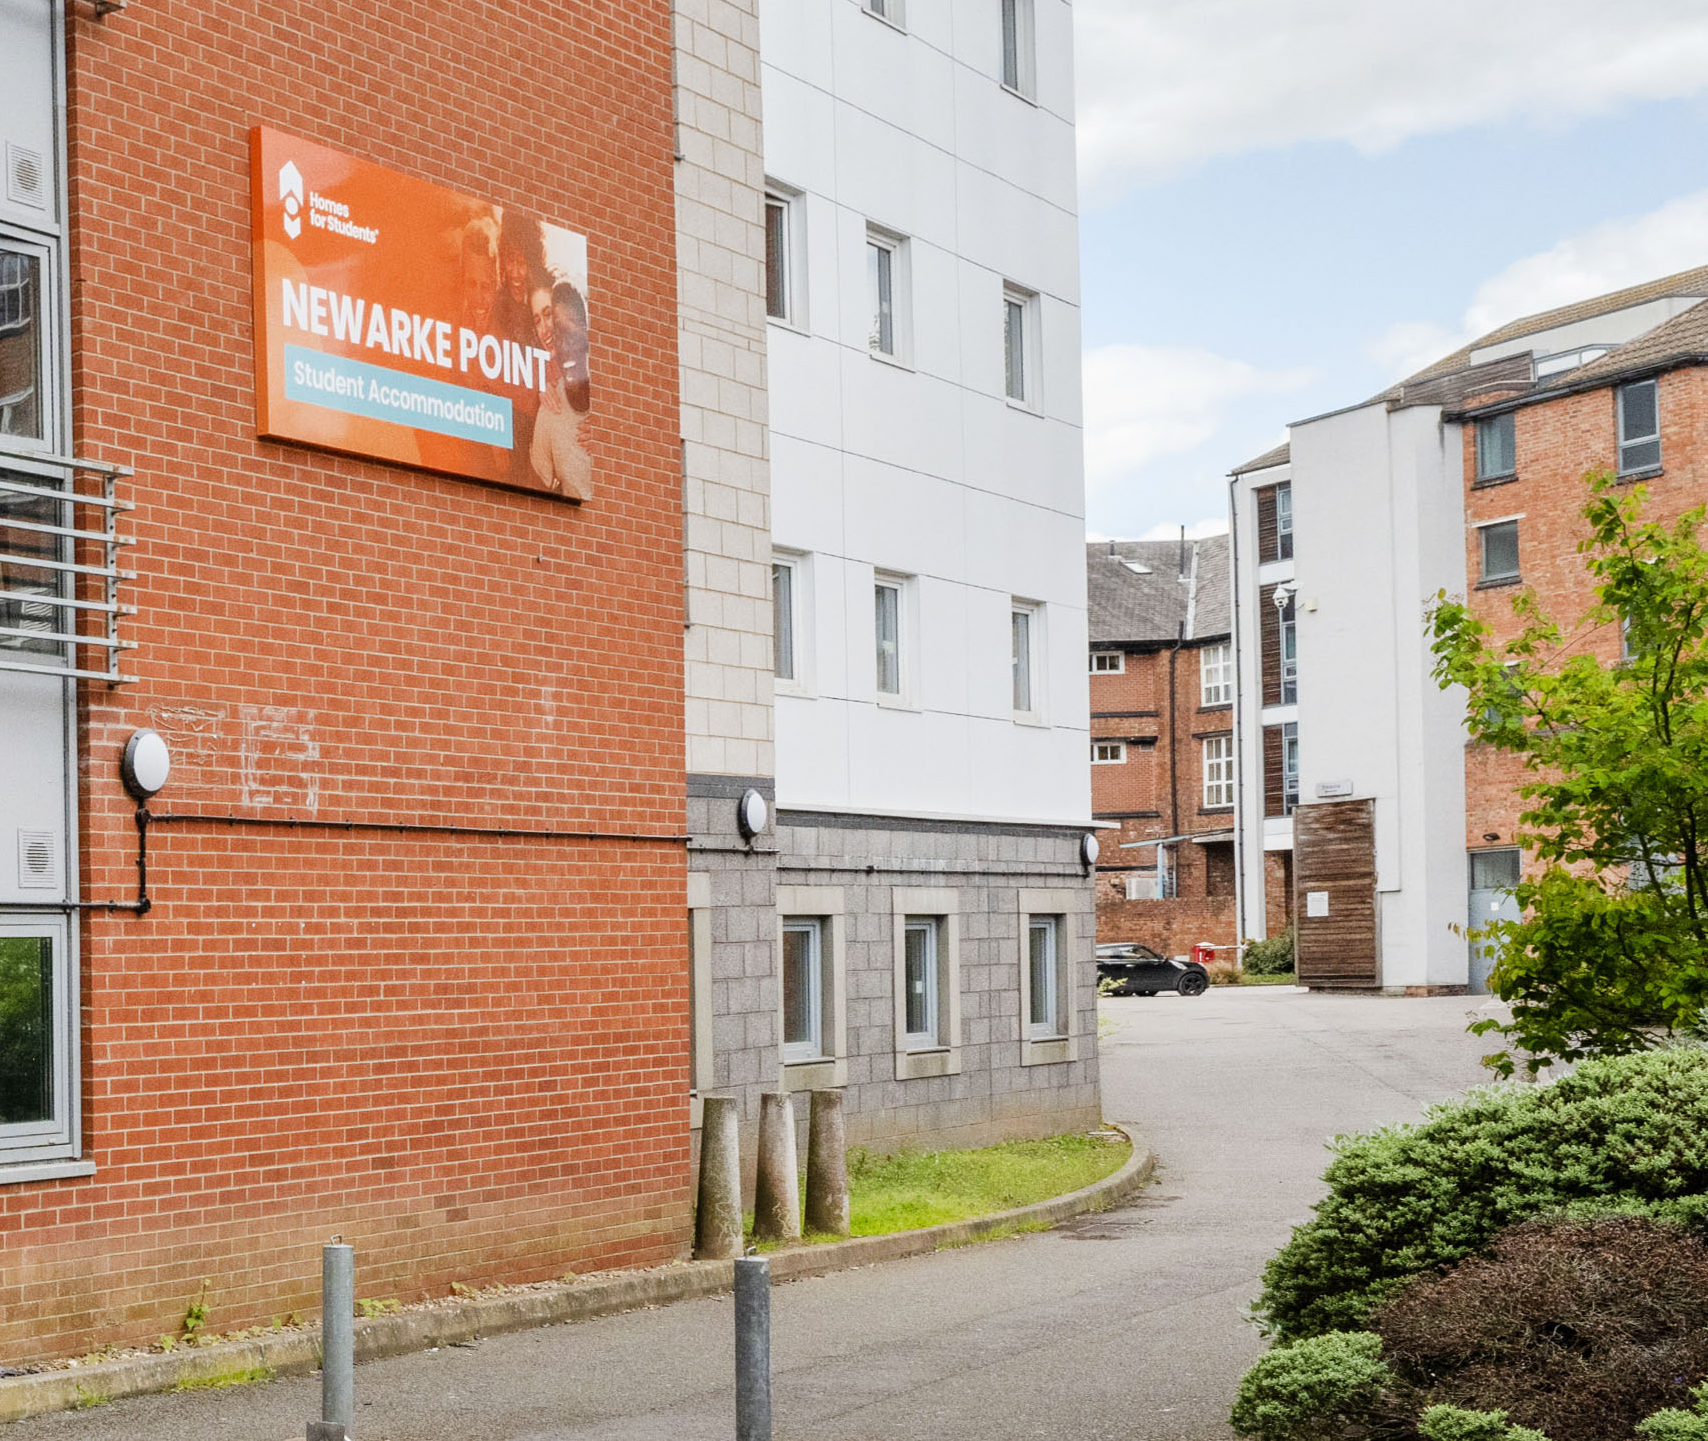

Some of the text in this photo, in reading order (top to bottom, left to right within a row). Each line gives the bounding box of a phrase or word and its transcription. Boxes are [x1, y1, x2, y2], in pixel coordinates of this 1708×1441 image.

[309, 191, 349, 218] Homes
[309, 208, 326, 229] for
[281, 278, 550, 392] NEWARKE POINT
[293, 360, 505, 432] Student Accommodation
